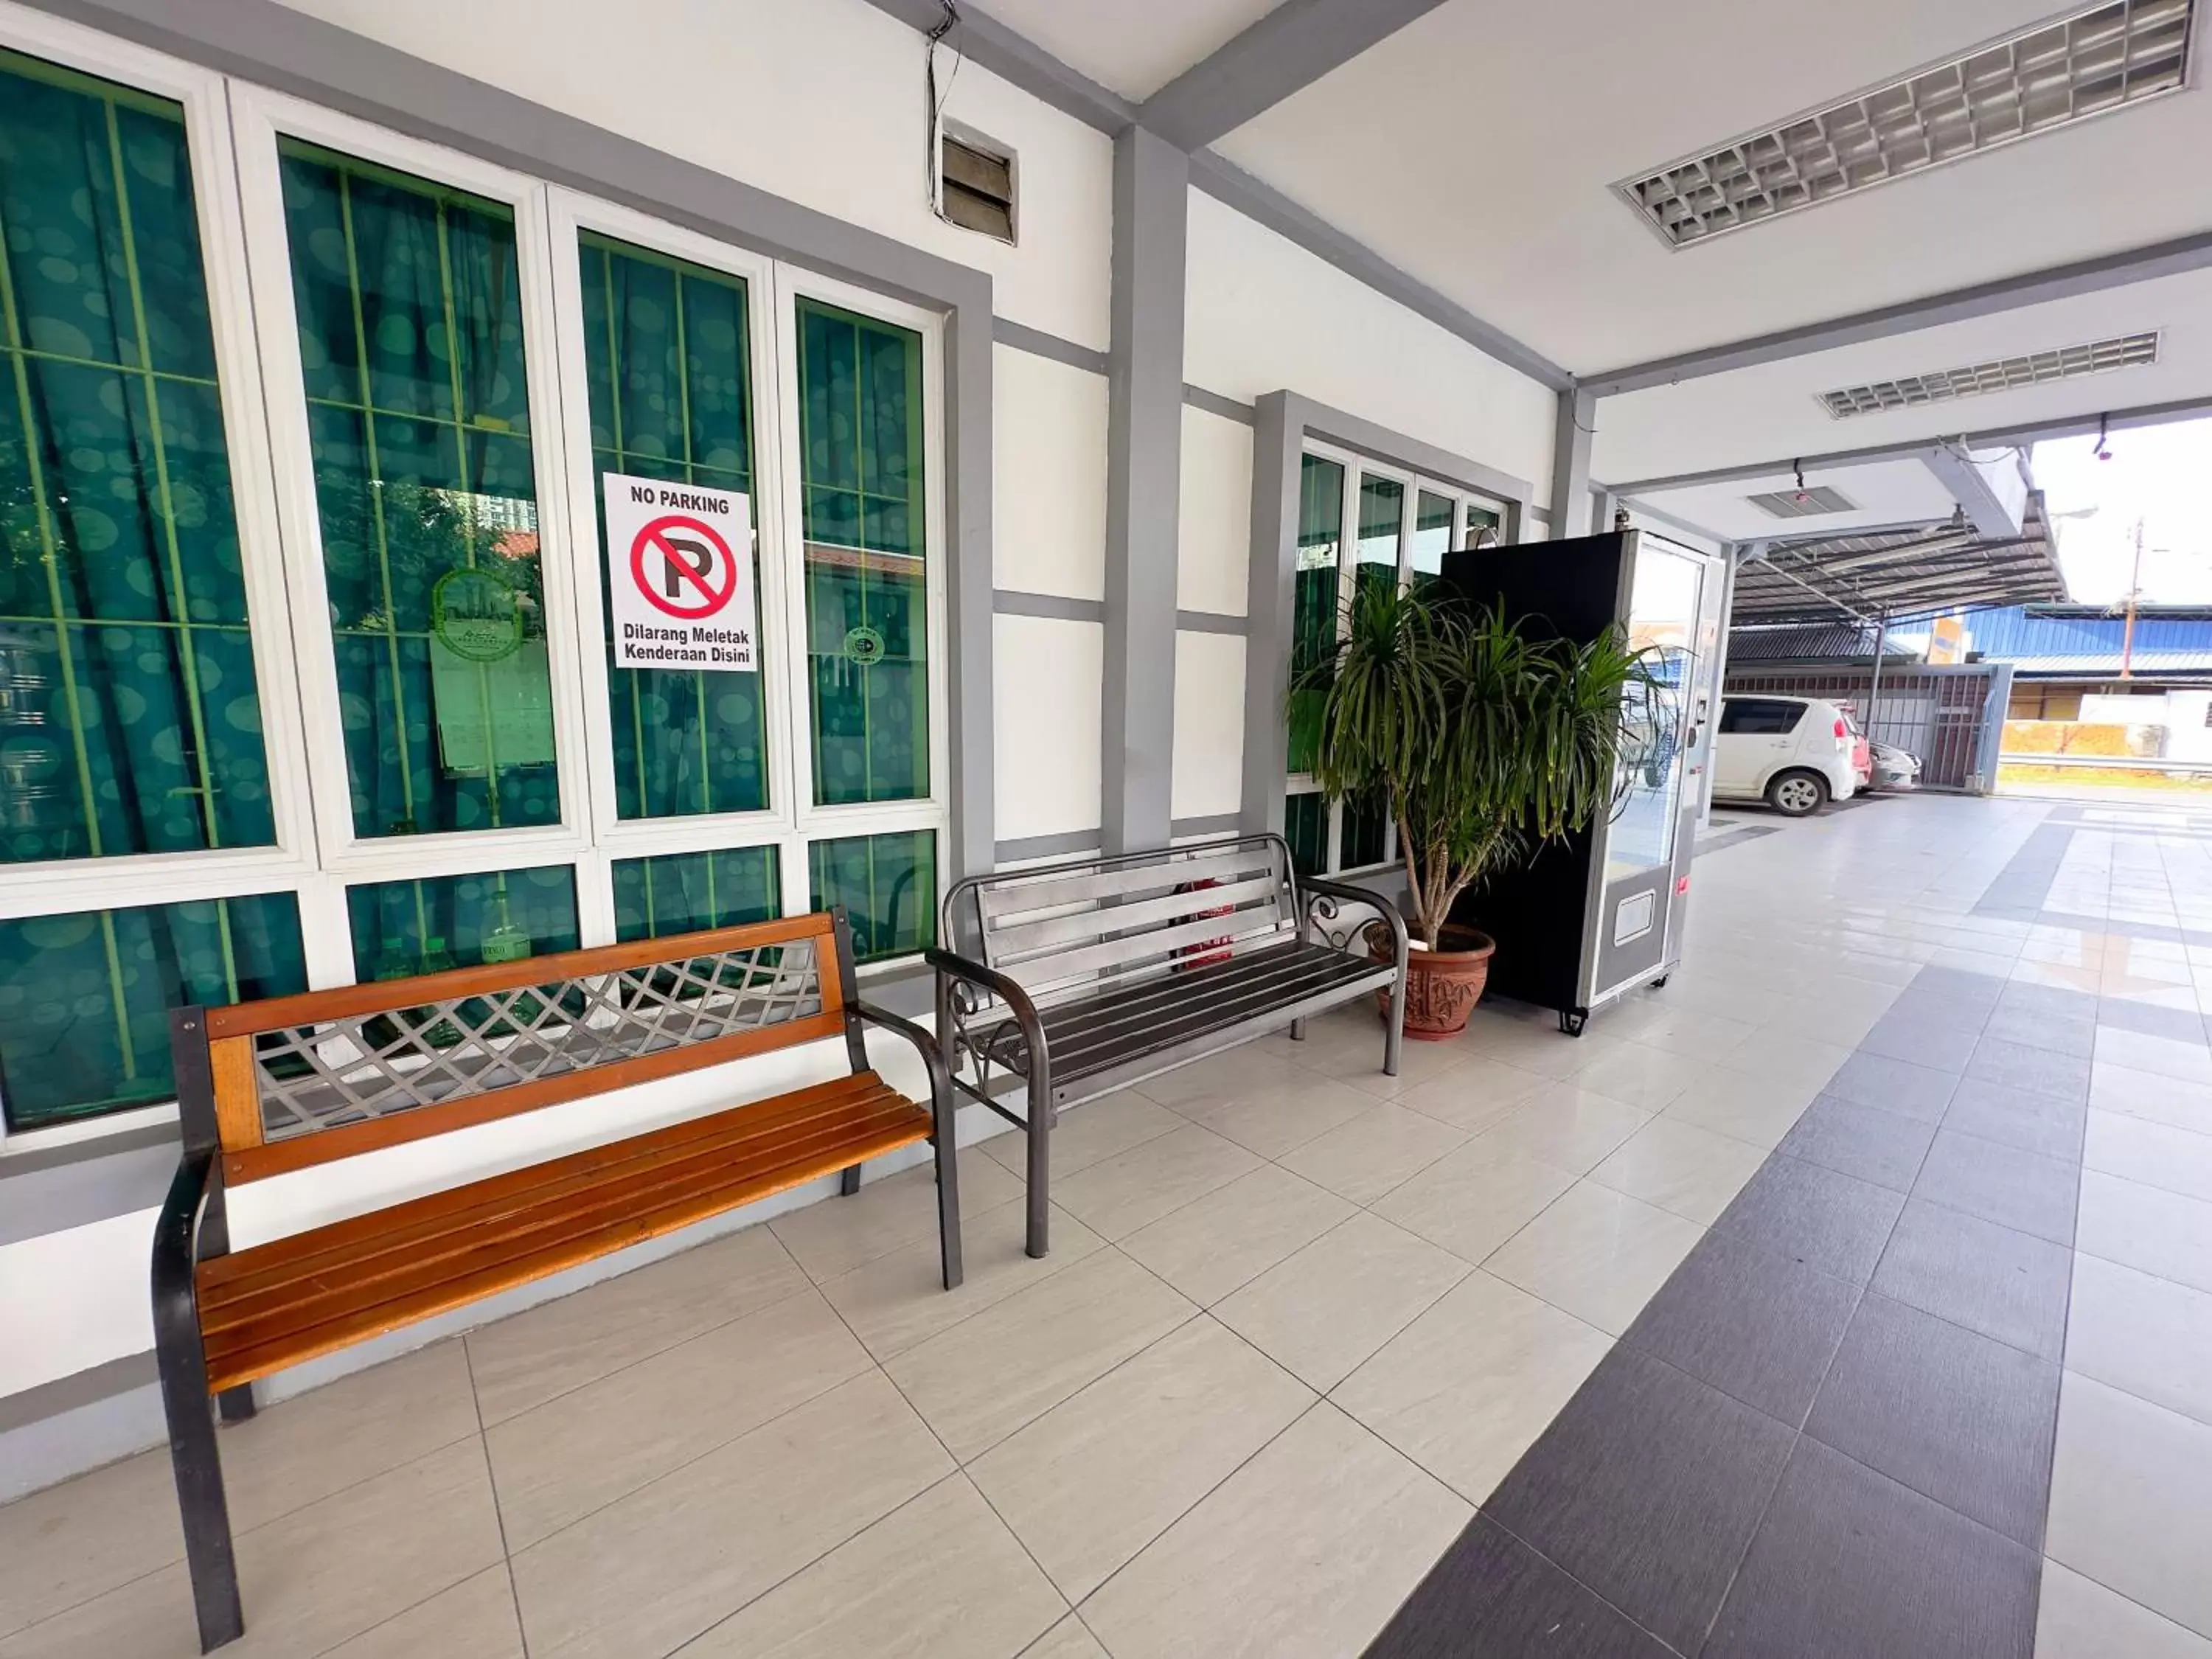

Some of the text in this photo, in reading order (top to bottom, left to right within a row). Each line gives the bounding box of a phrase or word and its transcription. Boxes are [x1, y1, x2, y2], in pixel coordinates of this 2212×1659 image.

[630, 486, 729, 515] NO PARKING
[623, 623, 749, 644] Dilarang Meletak
[625, 643, 750, 663] Kenderaan Disini
